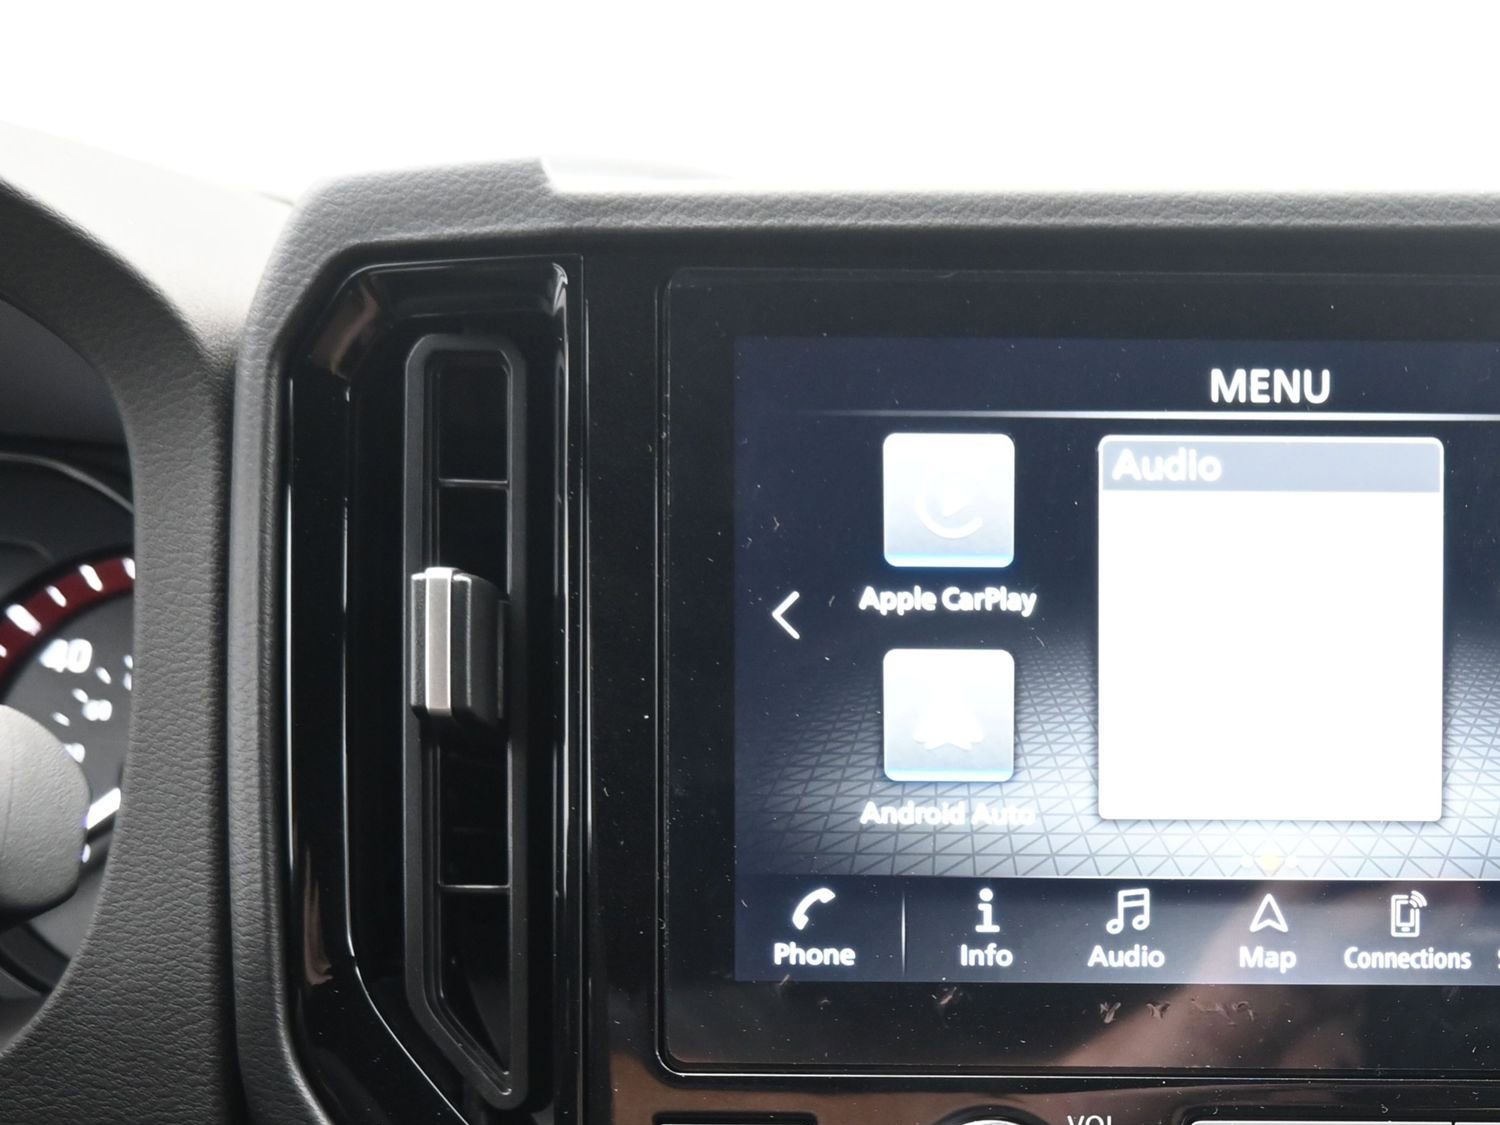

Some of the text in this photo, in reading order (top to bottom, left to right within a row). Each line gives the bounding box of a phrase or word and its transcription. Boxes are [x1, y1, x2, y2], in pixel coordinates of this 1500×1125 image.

[1210, 368, 1331, 404] MENU
[1112, 449, 1222, 481] Audio
[858, 586, 1037, 617] Apple CarPlay
[859, 800, 1037, 826] Android Auto
[774, 943, 856, 966] Phone
[960, 944, 1013, 967] Info
[1088, 945, 1165, 968] Audio
[1240, 946, 1296, 973] Map
[1344, 946, 1471, 970] Connections
